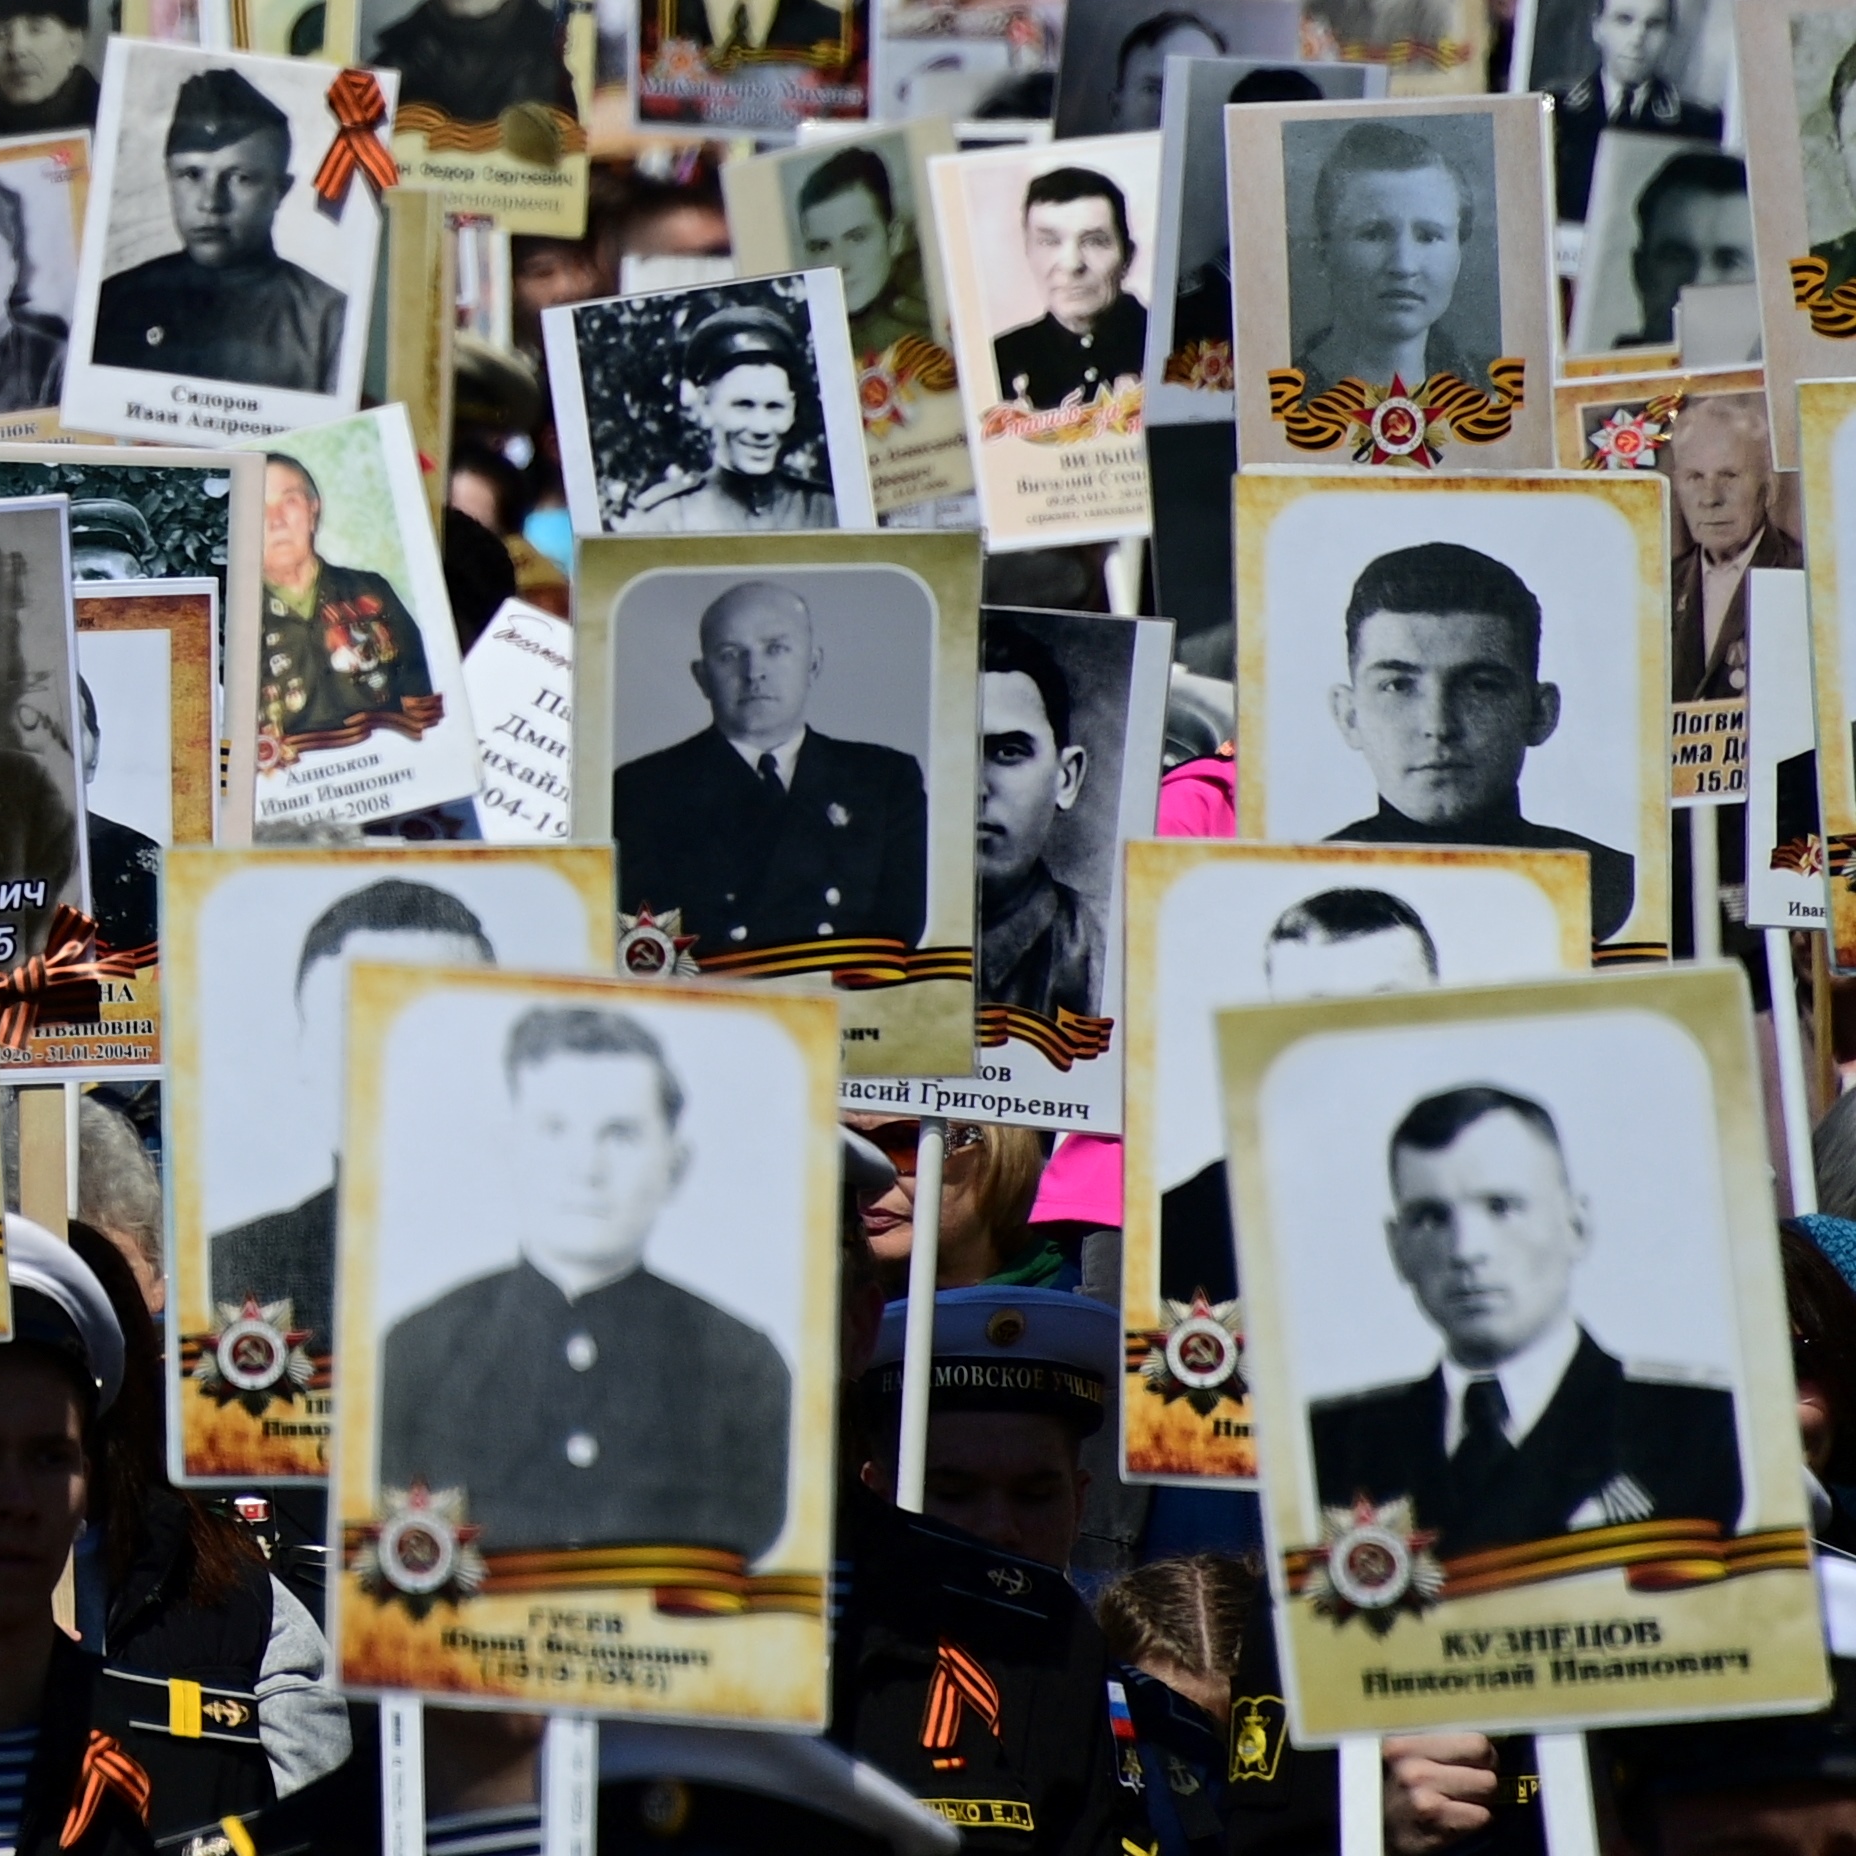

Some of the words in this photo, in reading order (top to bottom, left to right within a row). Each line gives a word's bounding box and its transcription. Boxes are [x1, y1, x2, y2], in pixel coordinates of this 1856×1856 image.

[126, 401, 179, 424] Иван
[171, 384, 259, 412] Сидоров
[1672, 710, 1745, 736] Логви
[316, 767, 415, 802] Иванович
[259, 793, 311, 817] Иван
[919, 1081, 1091, 1120] Григорьевич
[881, 1364, 1046, 1395] НАМОВСКОЕ
[1441, 1616, 1663, 1660] КУЗНЕЦОВ
[1362, 1662, 1536, 1698] Николай
[1548, 1647, 1751, 1687] Иванович
